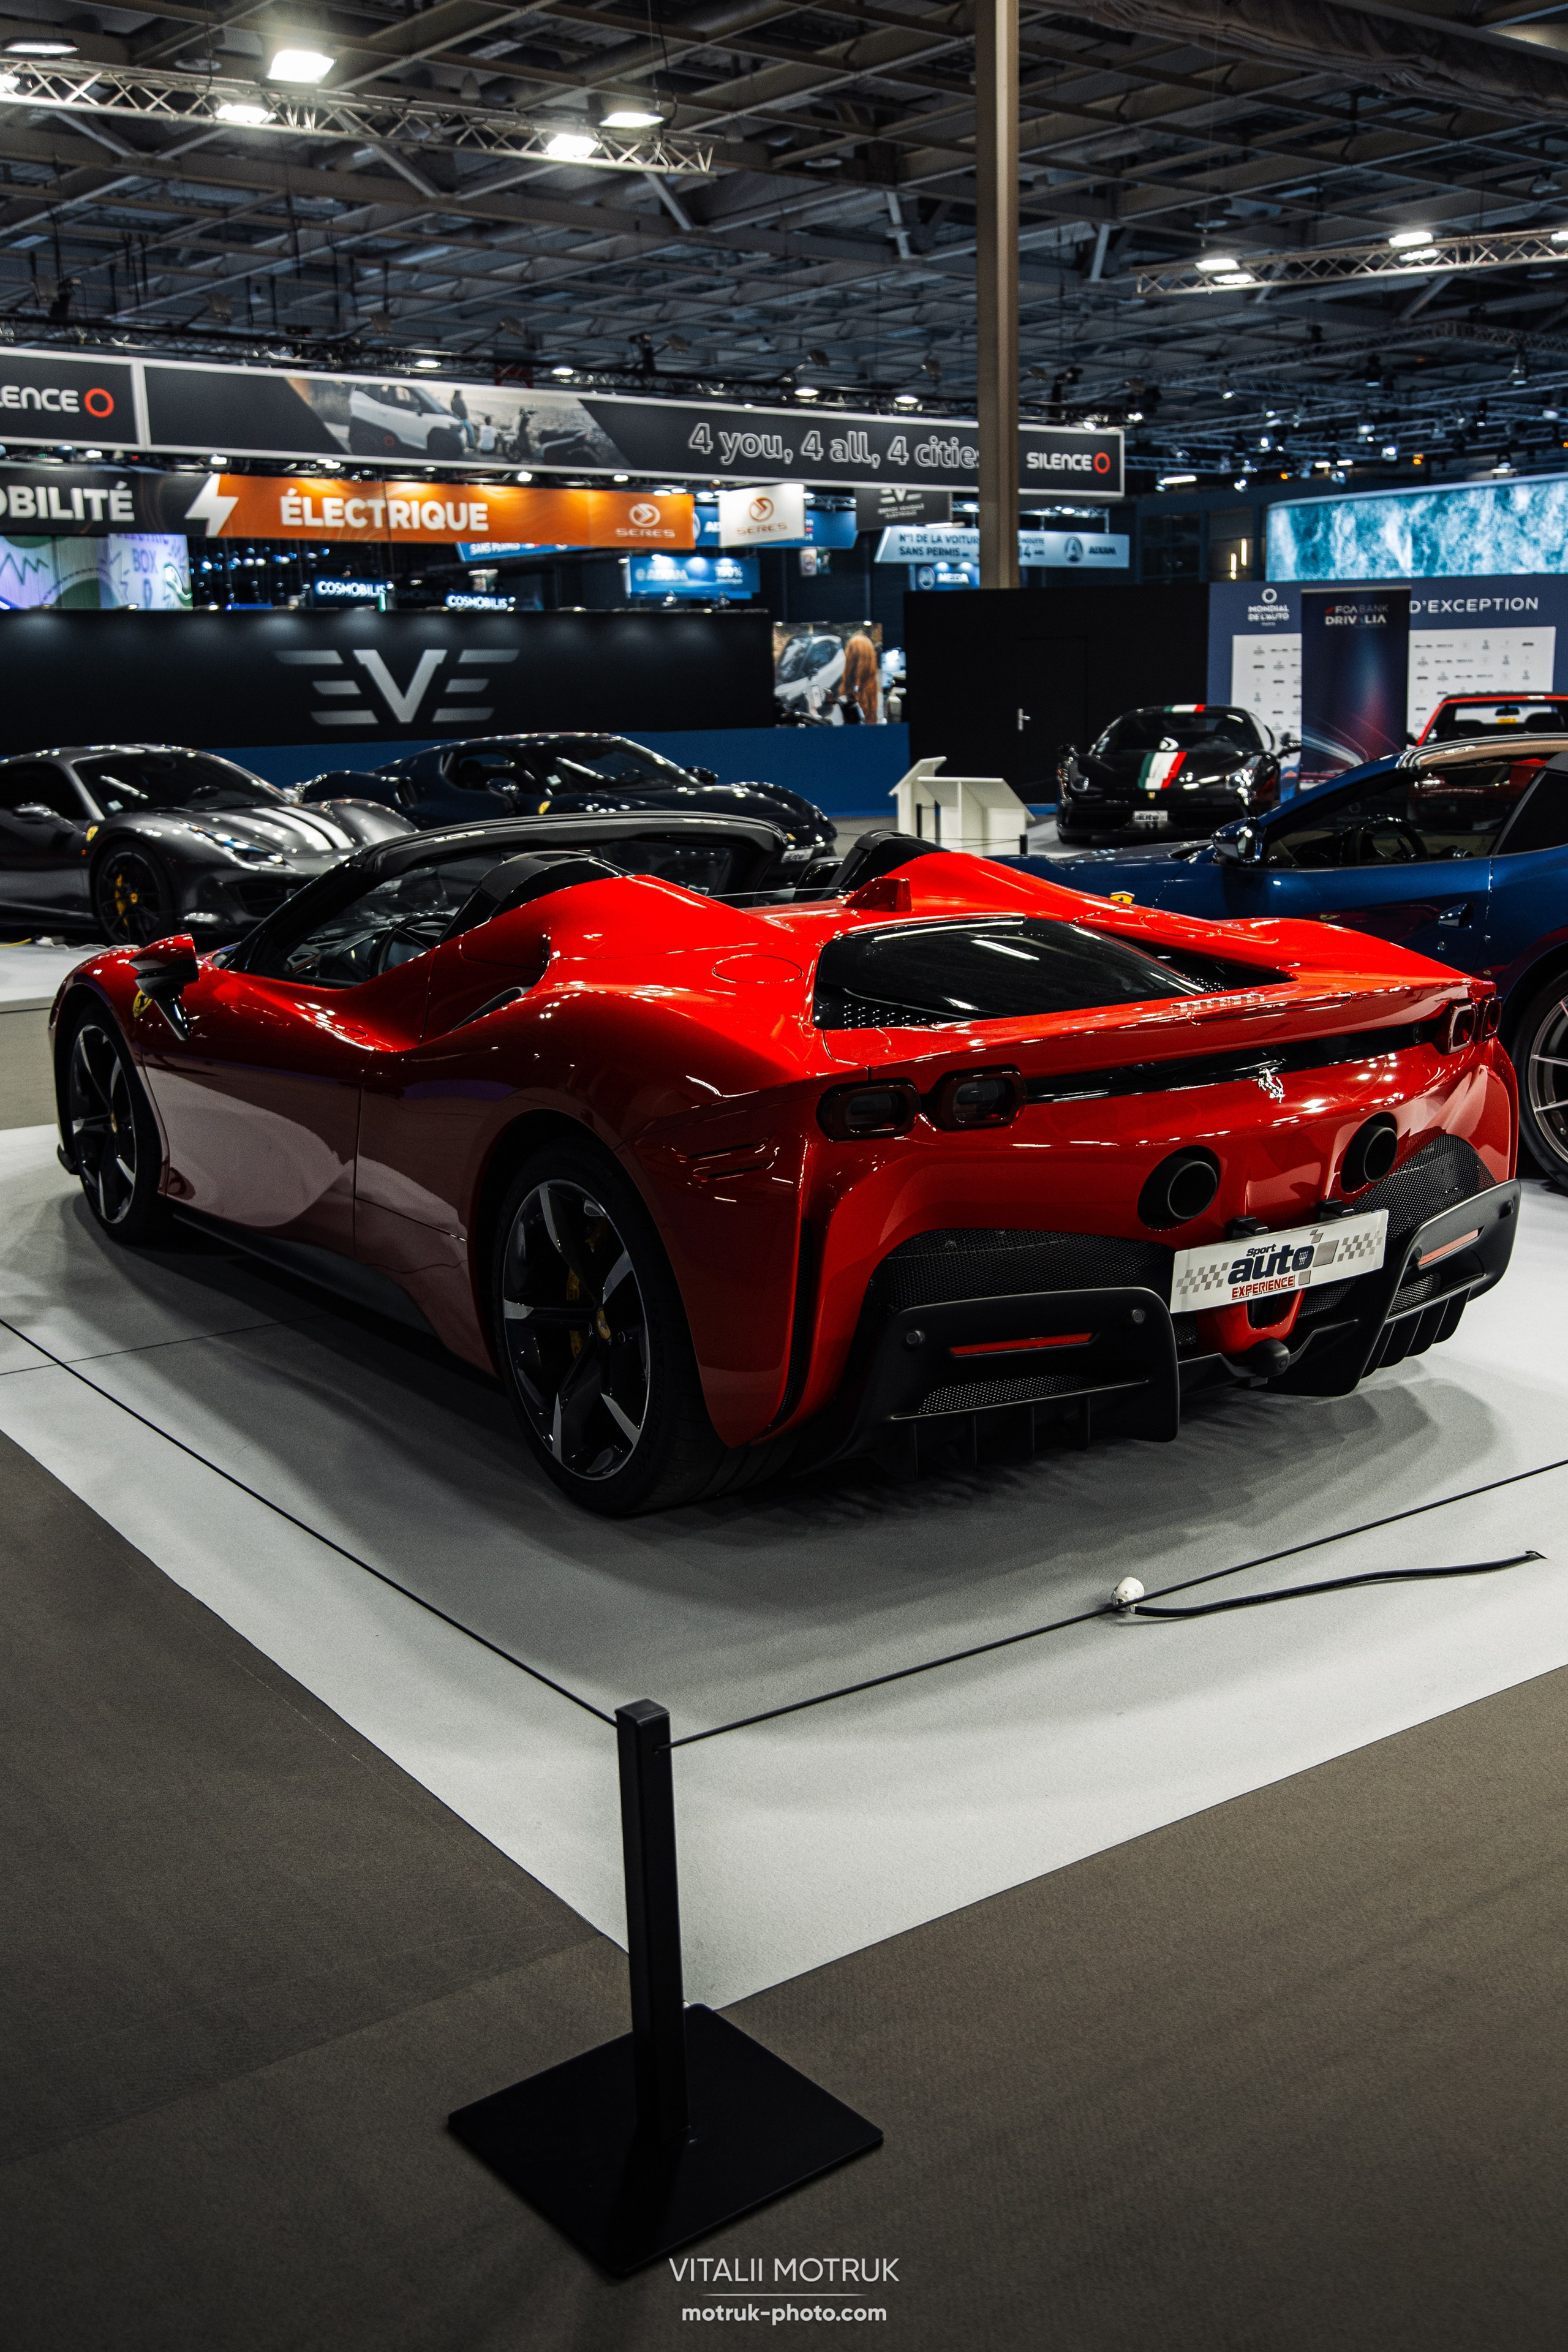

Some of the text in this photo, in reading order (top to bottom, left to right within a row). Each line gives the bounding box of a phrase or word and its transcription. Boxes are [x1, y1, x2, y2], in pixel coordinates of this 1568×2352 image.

[0, 385, 80, 413] ENCE
[688, 423, 979, 469] 4 you, 4 all, 4 citie
[0, 480, 135, 522] BILITÉ
[281, 488, 489, 532] ÉLECTRIQUE
[615, 527, 676, 538] SERES
[736, 521, 788, 536] SERES
[946, 535, 979, 545] VOITUR
[1409, 597, 1539, 614] D'EXCEPTION
[1246, 1243, 1276, 1257] Sport
[1227, 1244, 1314, 1284] auto
[1231, 1275, 1295, 1300] EXPERIENCE
